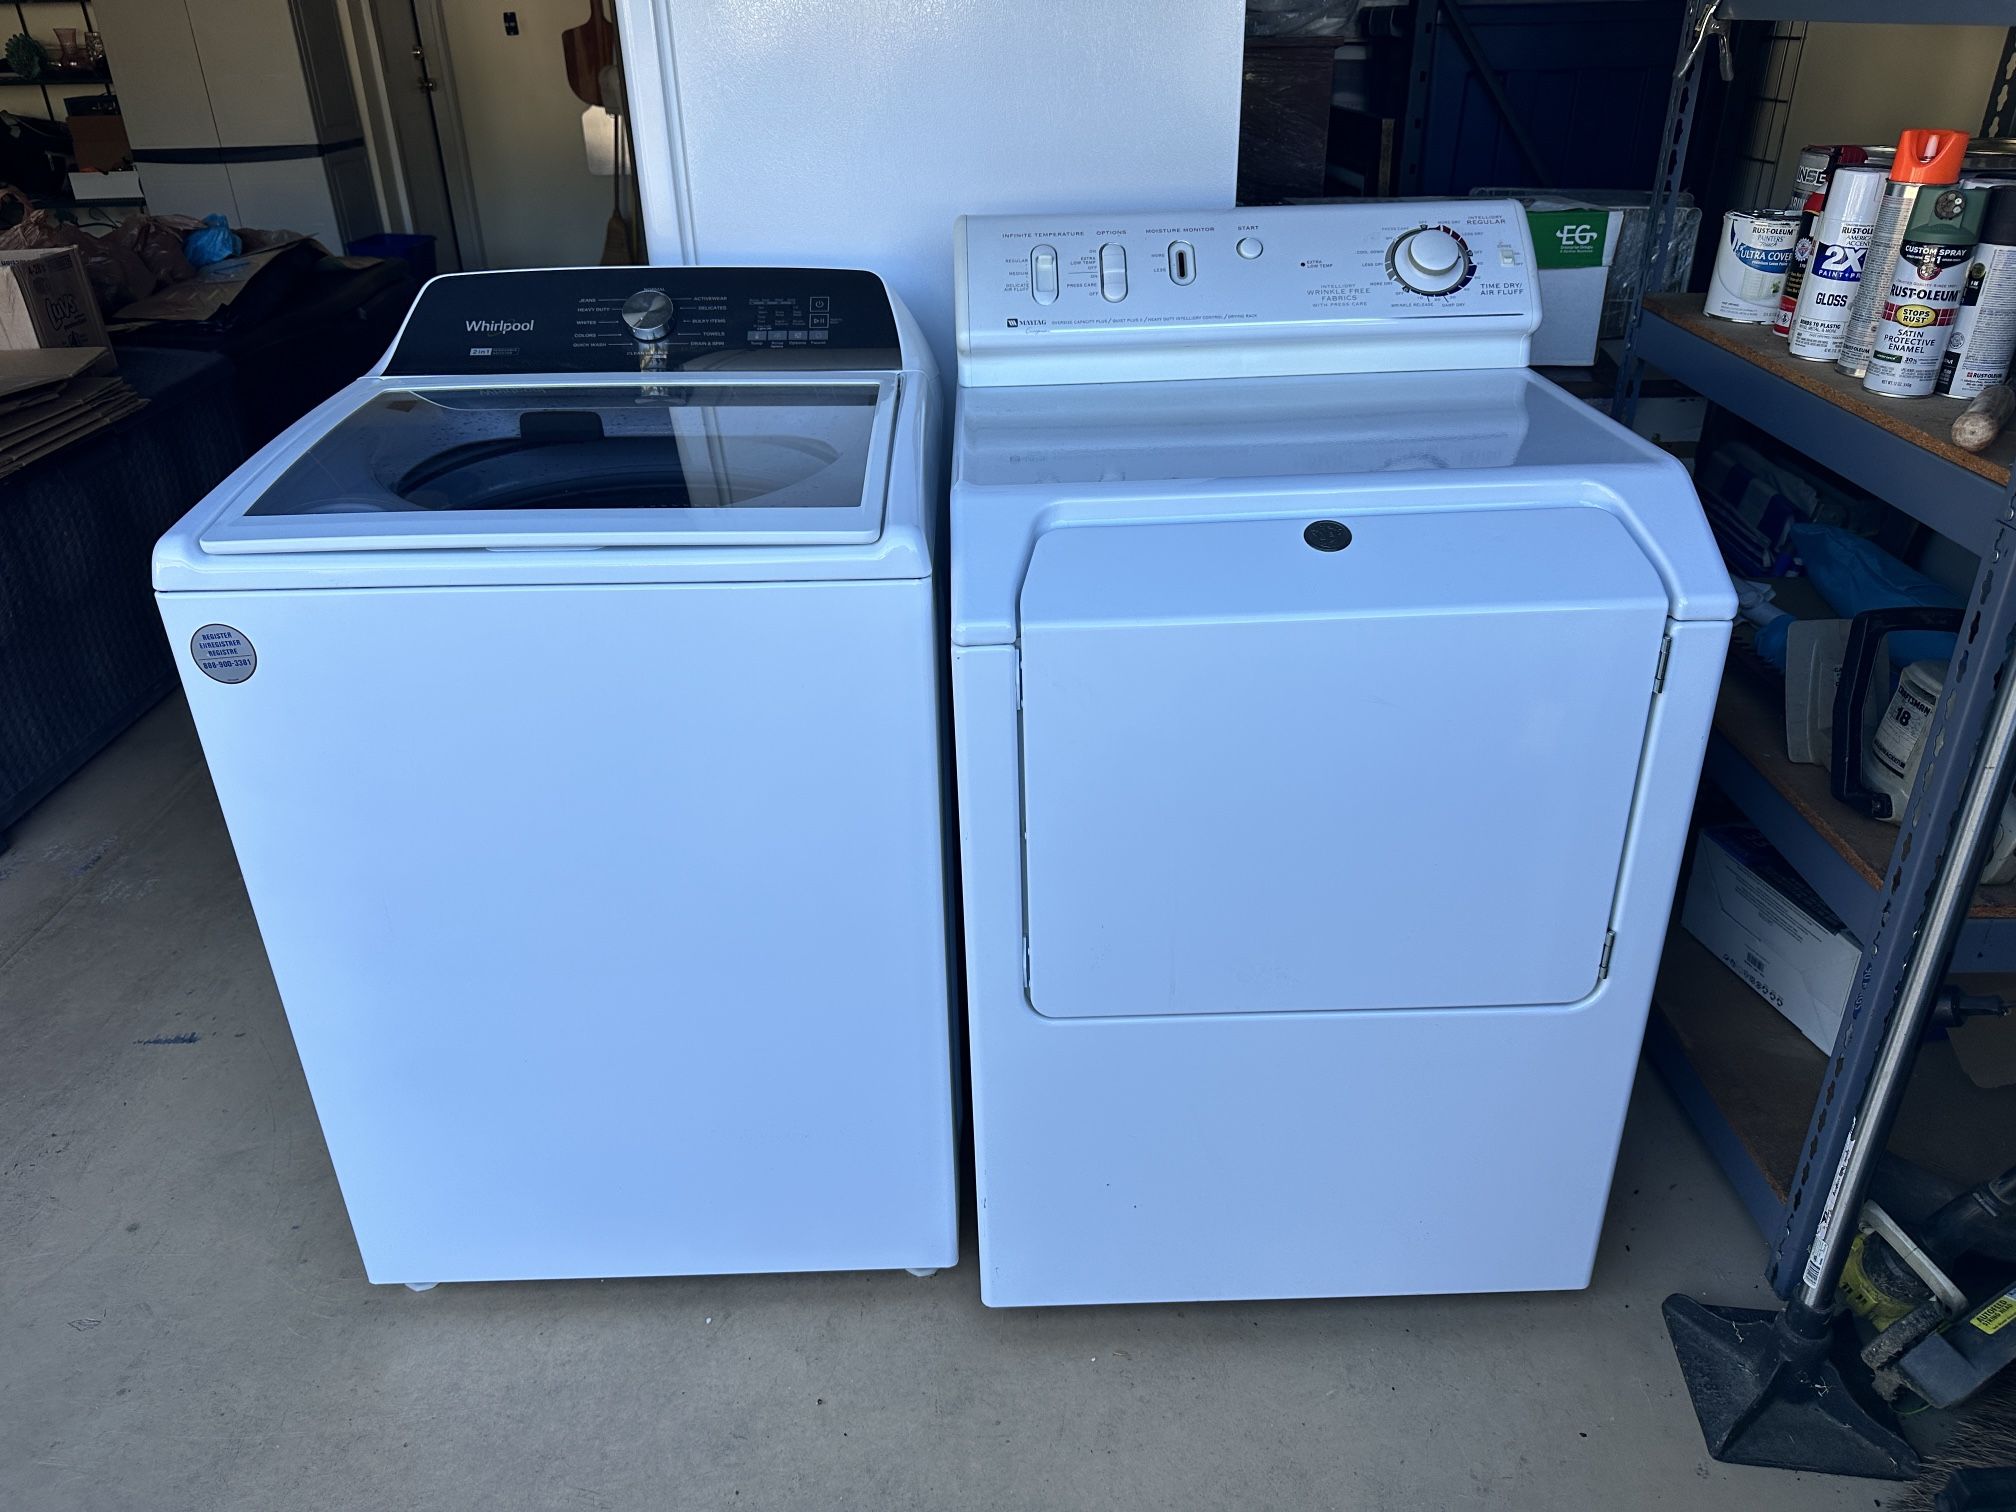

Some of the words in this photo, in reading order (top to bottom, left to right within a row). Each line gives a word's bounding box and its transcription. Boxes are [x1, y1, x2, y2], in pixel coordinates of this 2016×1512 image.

[1556, 225, 1598, 245] EG
[1752, 226, 1794, 236] RUST-OLEUM
[1740, 249, 1765, 260] ULTRA
[1905, 244, 1938, 255] CUSTOM
[1939, 248, 1967, 257] SPRAY
[1821, 244, 1868, 272] 2X
[1923, 255, 1931, 263] 5
[1818, 269, 1844, 278] PAINT
[1497, 288, 1524, 296] FLUFF
[1889, 283, 1959, 302] RUST-OLEUM
[1815, 292, 1848, 307] GLOSS
[1902, 308, 1930, 317] STOPS
[1820, 321, 1841, 329] PLASTIC
[1902, 315, 1926, 324] RUST
[465, 319, 535, 335] Whirlpool
[1896, 329, 1925, 338] SATIN
[1883, 334, 1936, 346] PROTECTIVE
[1888, 343, 1925, 354] ENAMEL
[201, 632, 233, 641] REGISTER
[199, 639, 242, 649] ENREGISTRER
[1895, 706, 1912, 727] 18
[1976, 1299, 2008, 1323] AUTOFEED
